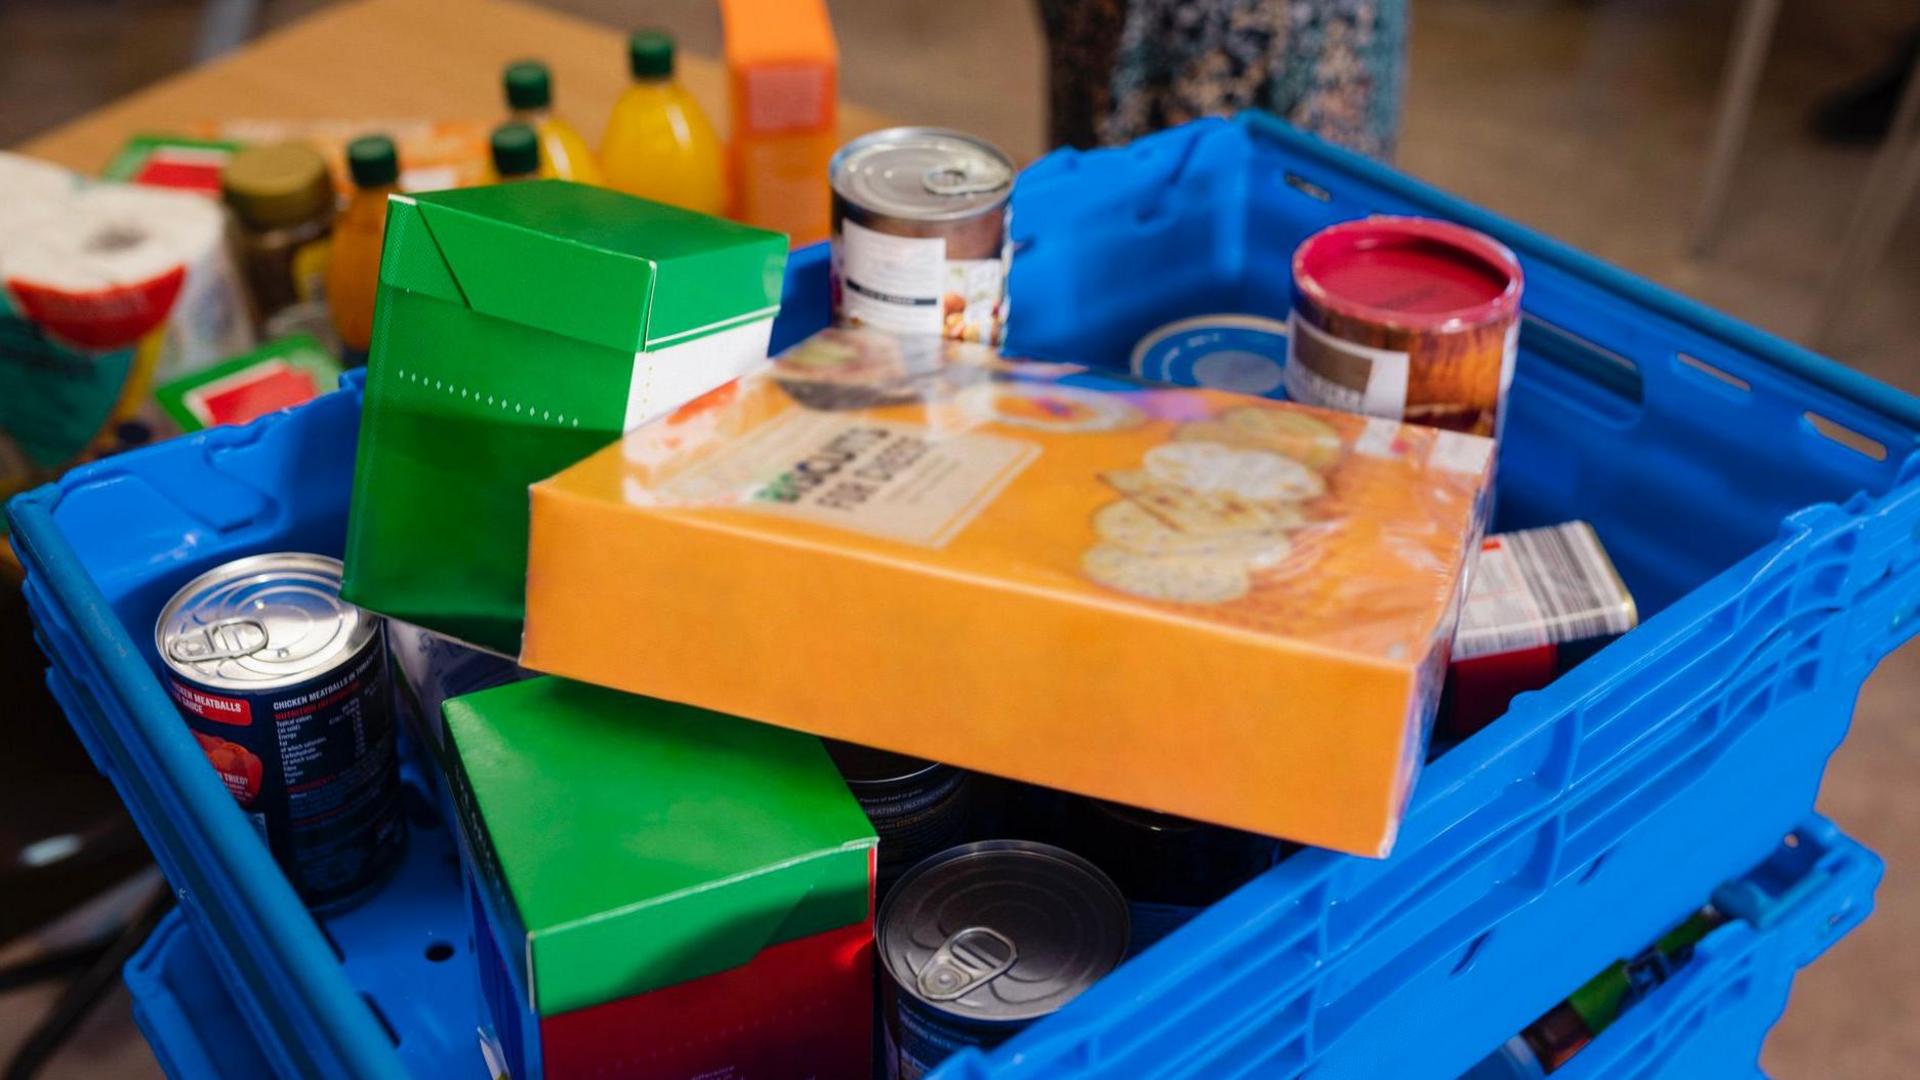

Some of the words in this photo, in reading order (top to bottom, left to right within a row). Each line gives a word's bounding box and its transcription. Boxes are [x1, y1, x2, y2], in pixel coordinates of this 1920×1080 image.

[193, 693, 242, 713] MEATBALLS
[273, 696, 308, 711] CHICKEN
[308, 677, 349, 701] MEATBALLS
[181, 696, 204, 715] SAUCE
[278, 732, 297, 741] Energy
